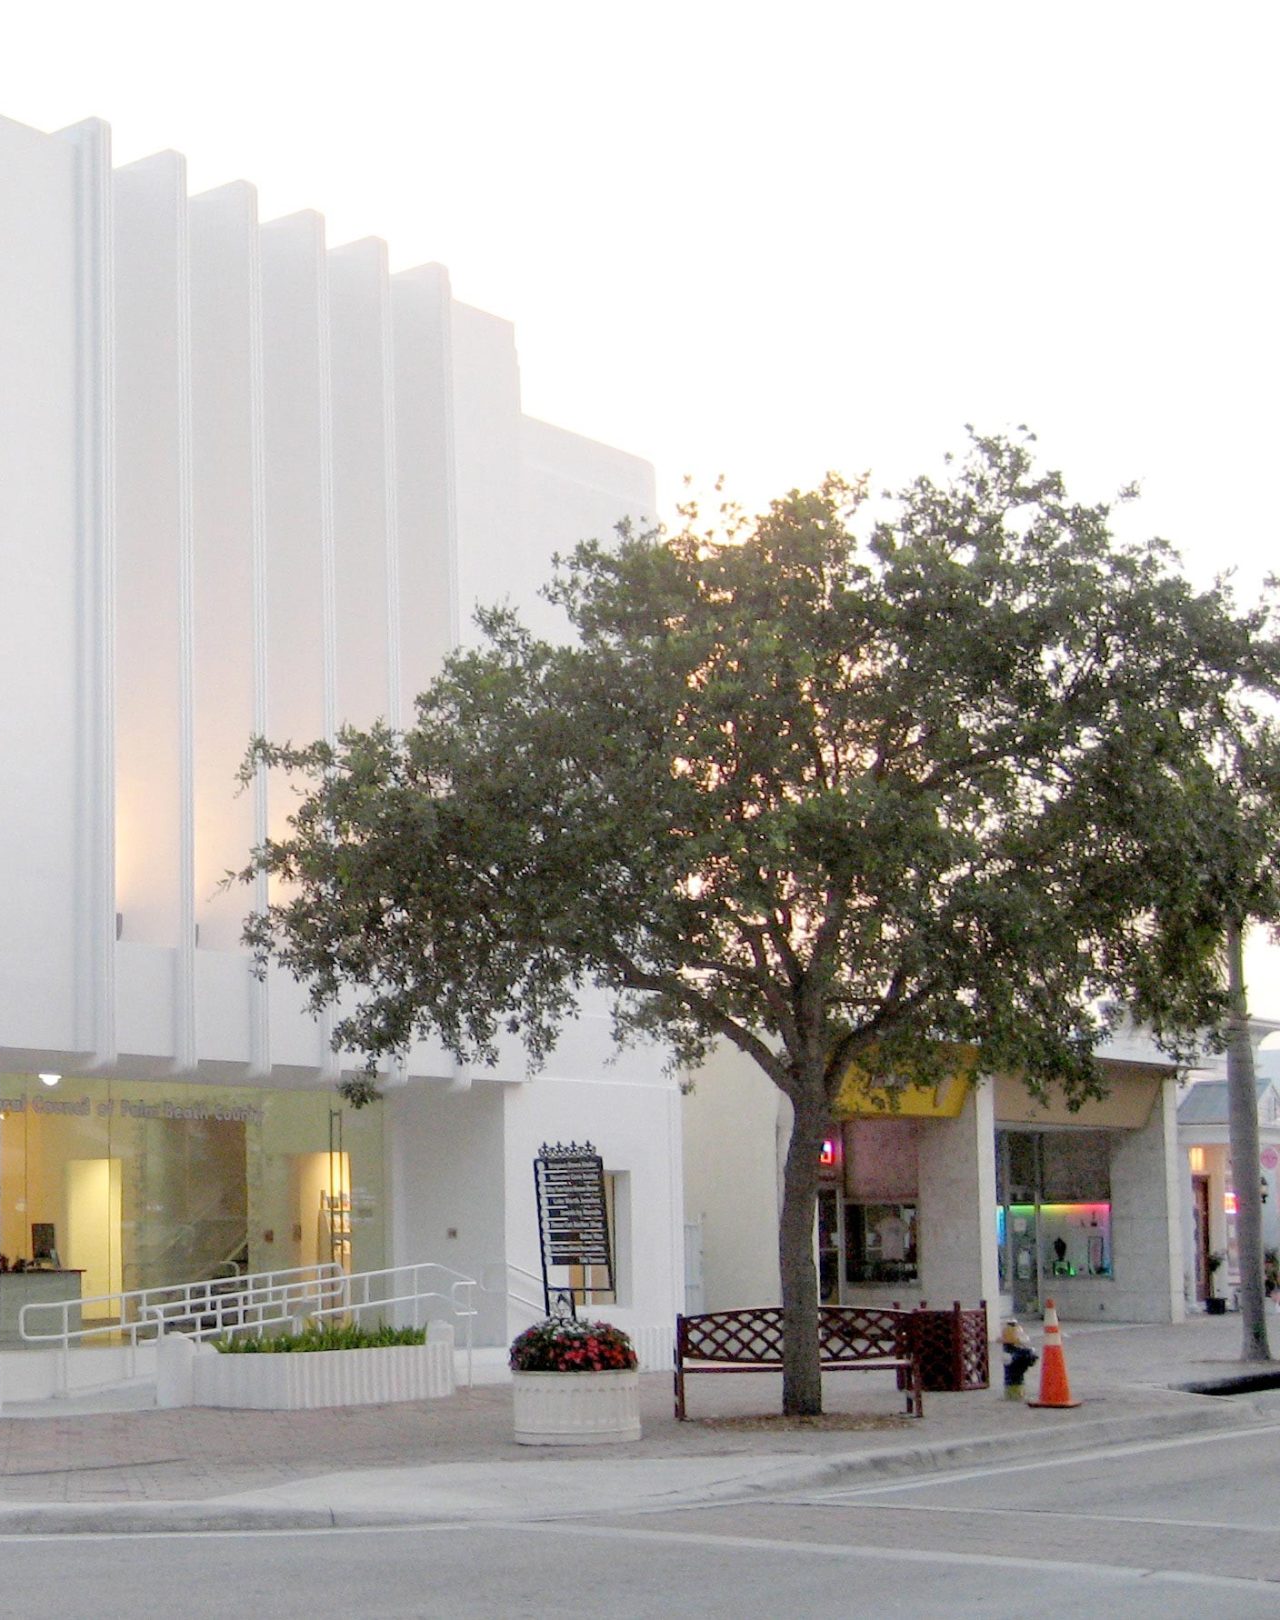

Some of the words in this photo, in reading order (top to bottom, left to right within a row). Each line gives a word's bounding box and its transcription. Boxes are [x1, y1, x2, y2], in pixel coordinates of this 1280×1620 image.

[31, 1093, 90, 1116] Council
[96, 1098, 113, 1117] of
[164, 1099, 208, 1120] Beach
